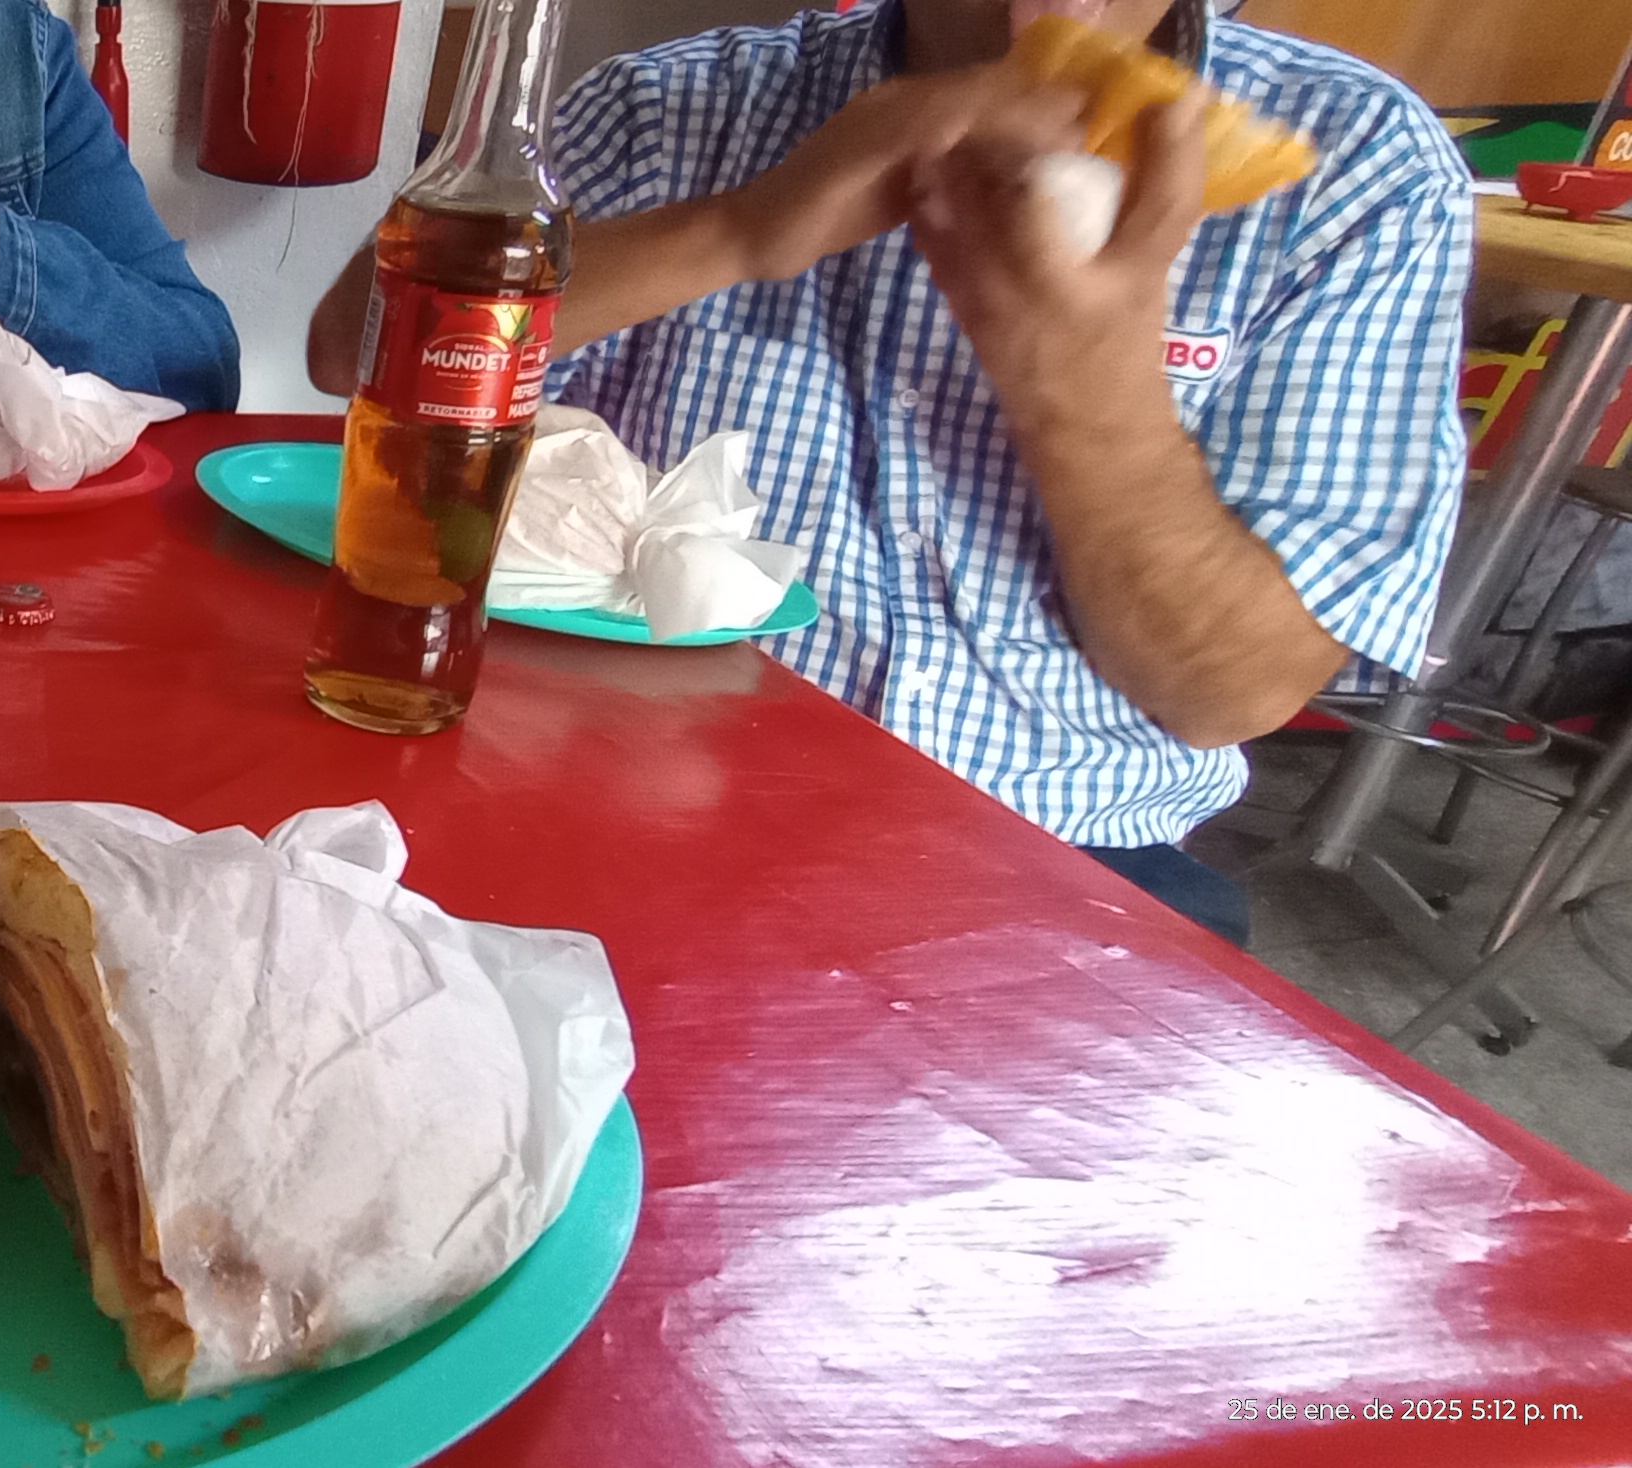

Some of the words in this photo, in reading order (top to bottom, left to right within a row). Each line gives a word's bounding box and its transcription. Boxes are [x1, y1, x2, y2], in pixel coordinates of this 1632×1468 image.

[421, 348, 512, 373] MUNDET
[1165, 341, 1218, 371] BO
[423, 404, 493, 418] RETORNABLE
